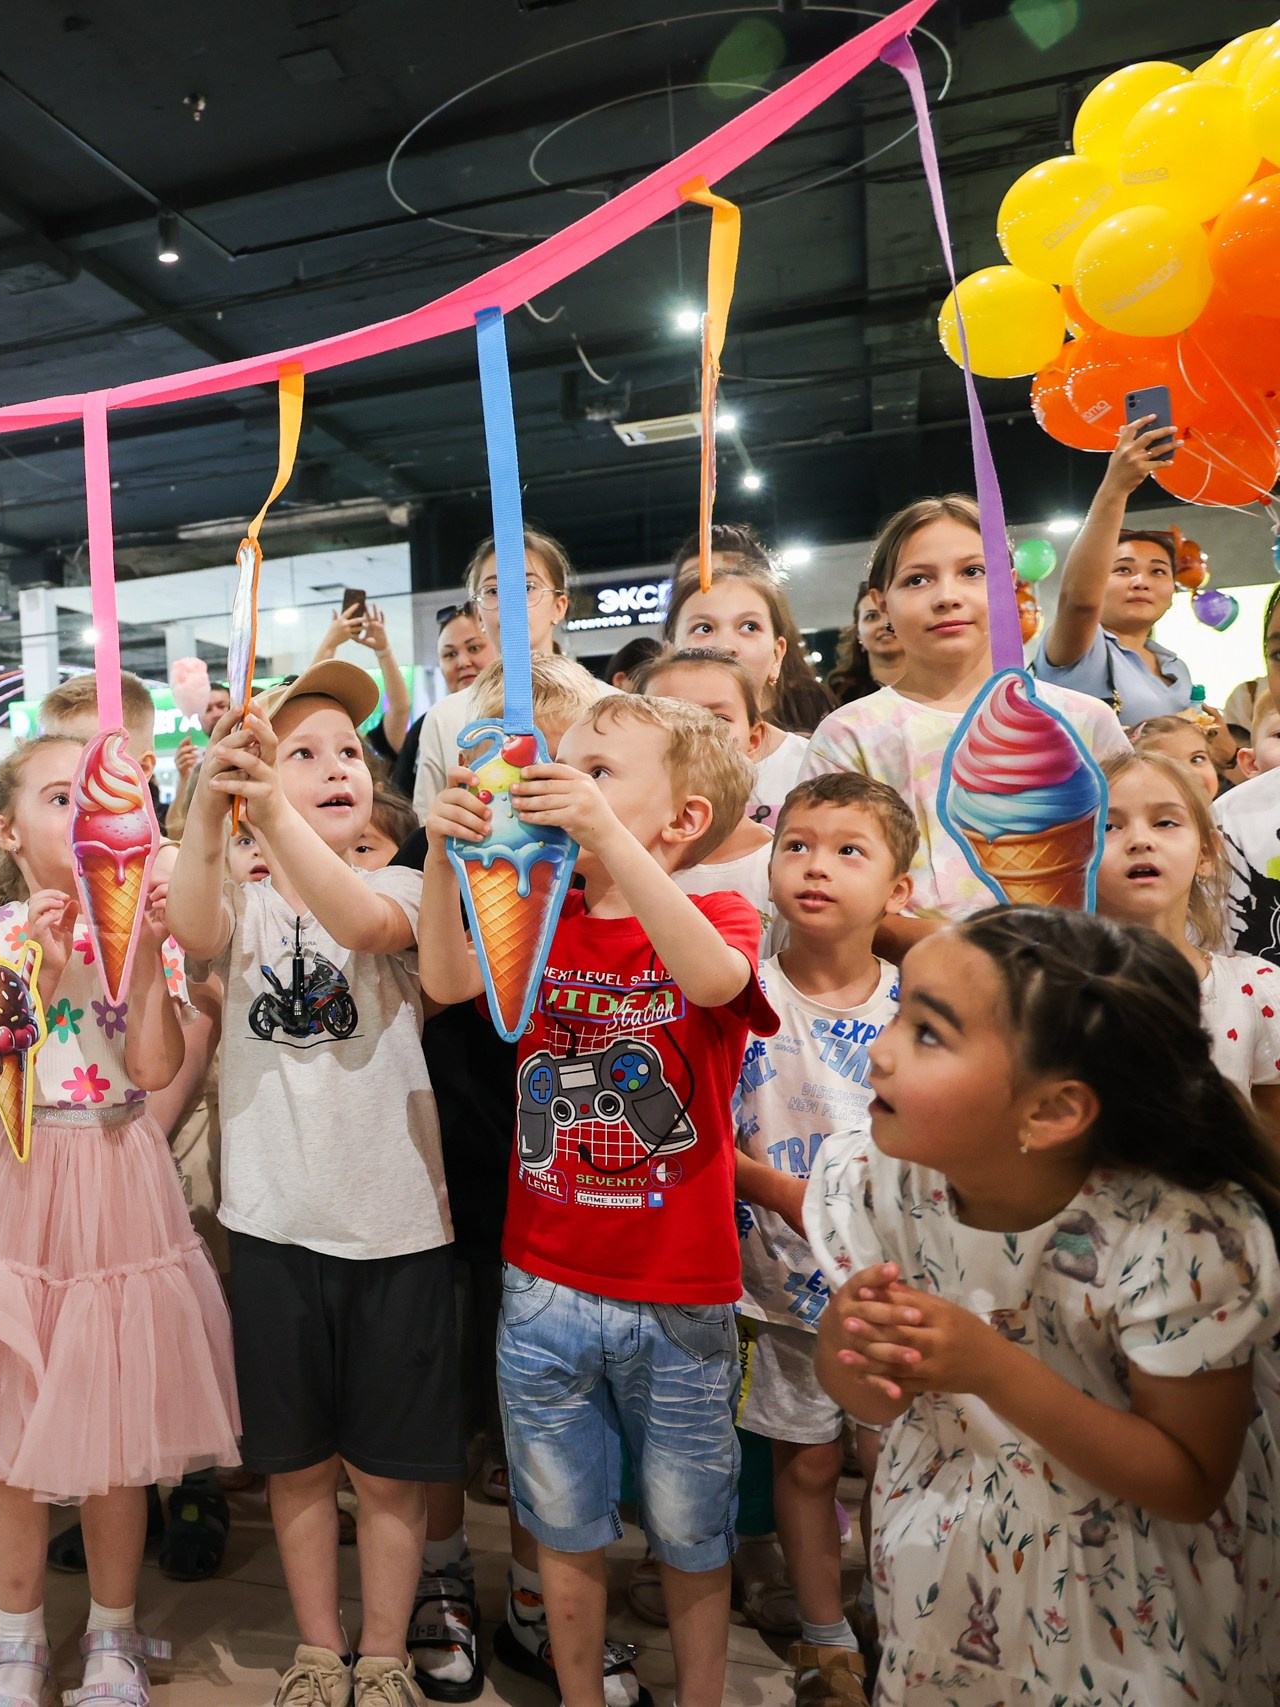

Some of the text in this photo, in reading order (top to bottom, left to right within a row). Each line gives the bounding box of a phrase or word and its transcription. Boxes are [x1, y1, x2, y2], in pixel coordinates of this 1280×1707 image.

[576, 970, 624, 986] LEVEL
[605, 998, 676, 1031] Station
[802, 1082, 870, 1109] DISCOVER
[788, 1096, 870, 1125] NEW PLACE
[528, 1176, 564, 1197] LEVEL
[575, 1173, 648, 1187] SEVENTY
[579, 1194, 639, 1205] GAME OVER
